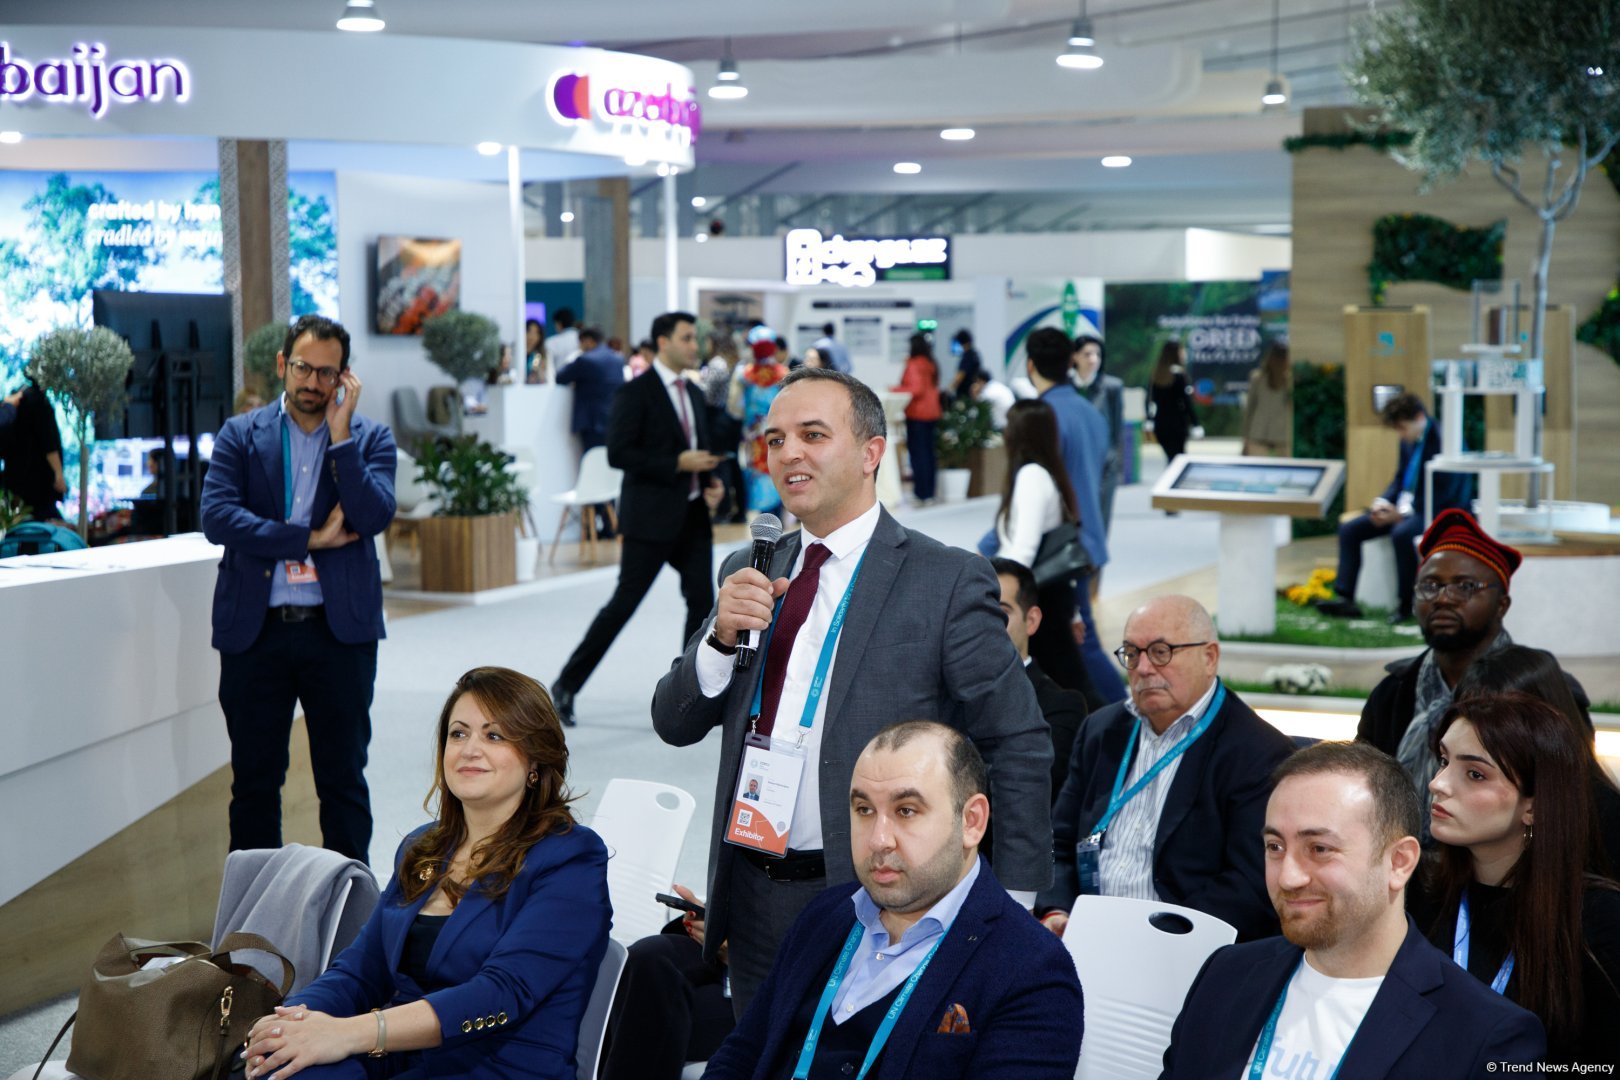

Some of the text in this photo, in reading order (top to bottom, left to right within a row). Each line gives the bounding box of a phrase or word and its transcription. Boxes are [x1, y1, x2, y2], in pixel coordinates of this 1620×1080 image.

[0, 41, 188, 119] baijan
[735, 828, 764, 841] Exhibitor
[834, 951, 849, 975] Climate
[888, 1007, 898, 1019] UN
[895, 982, 913, 1006] Climate
